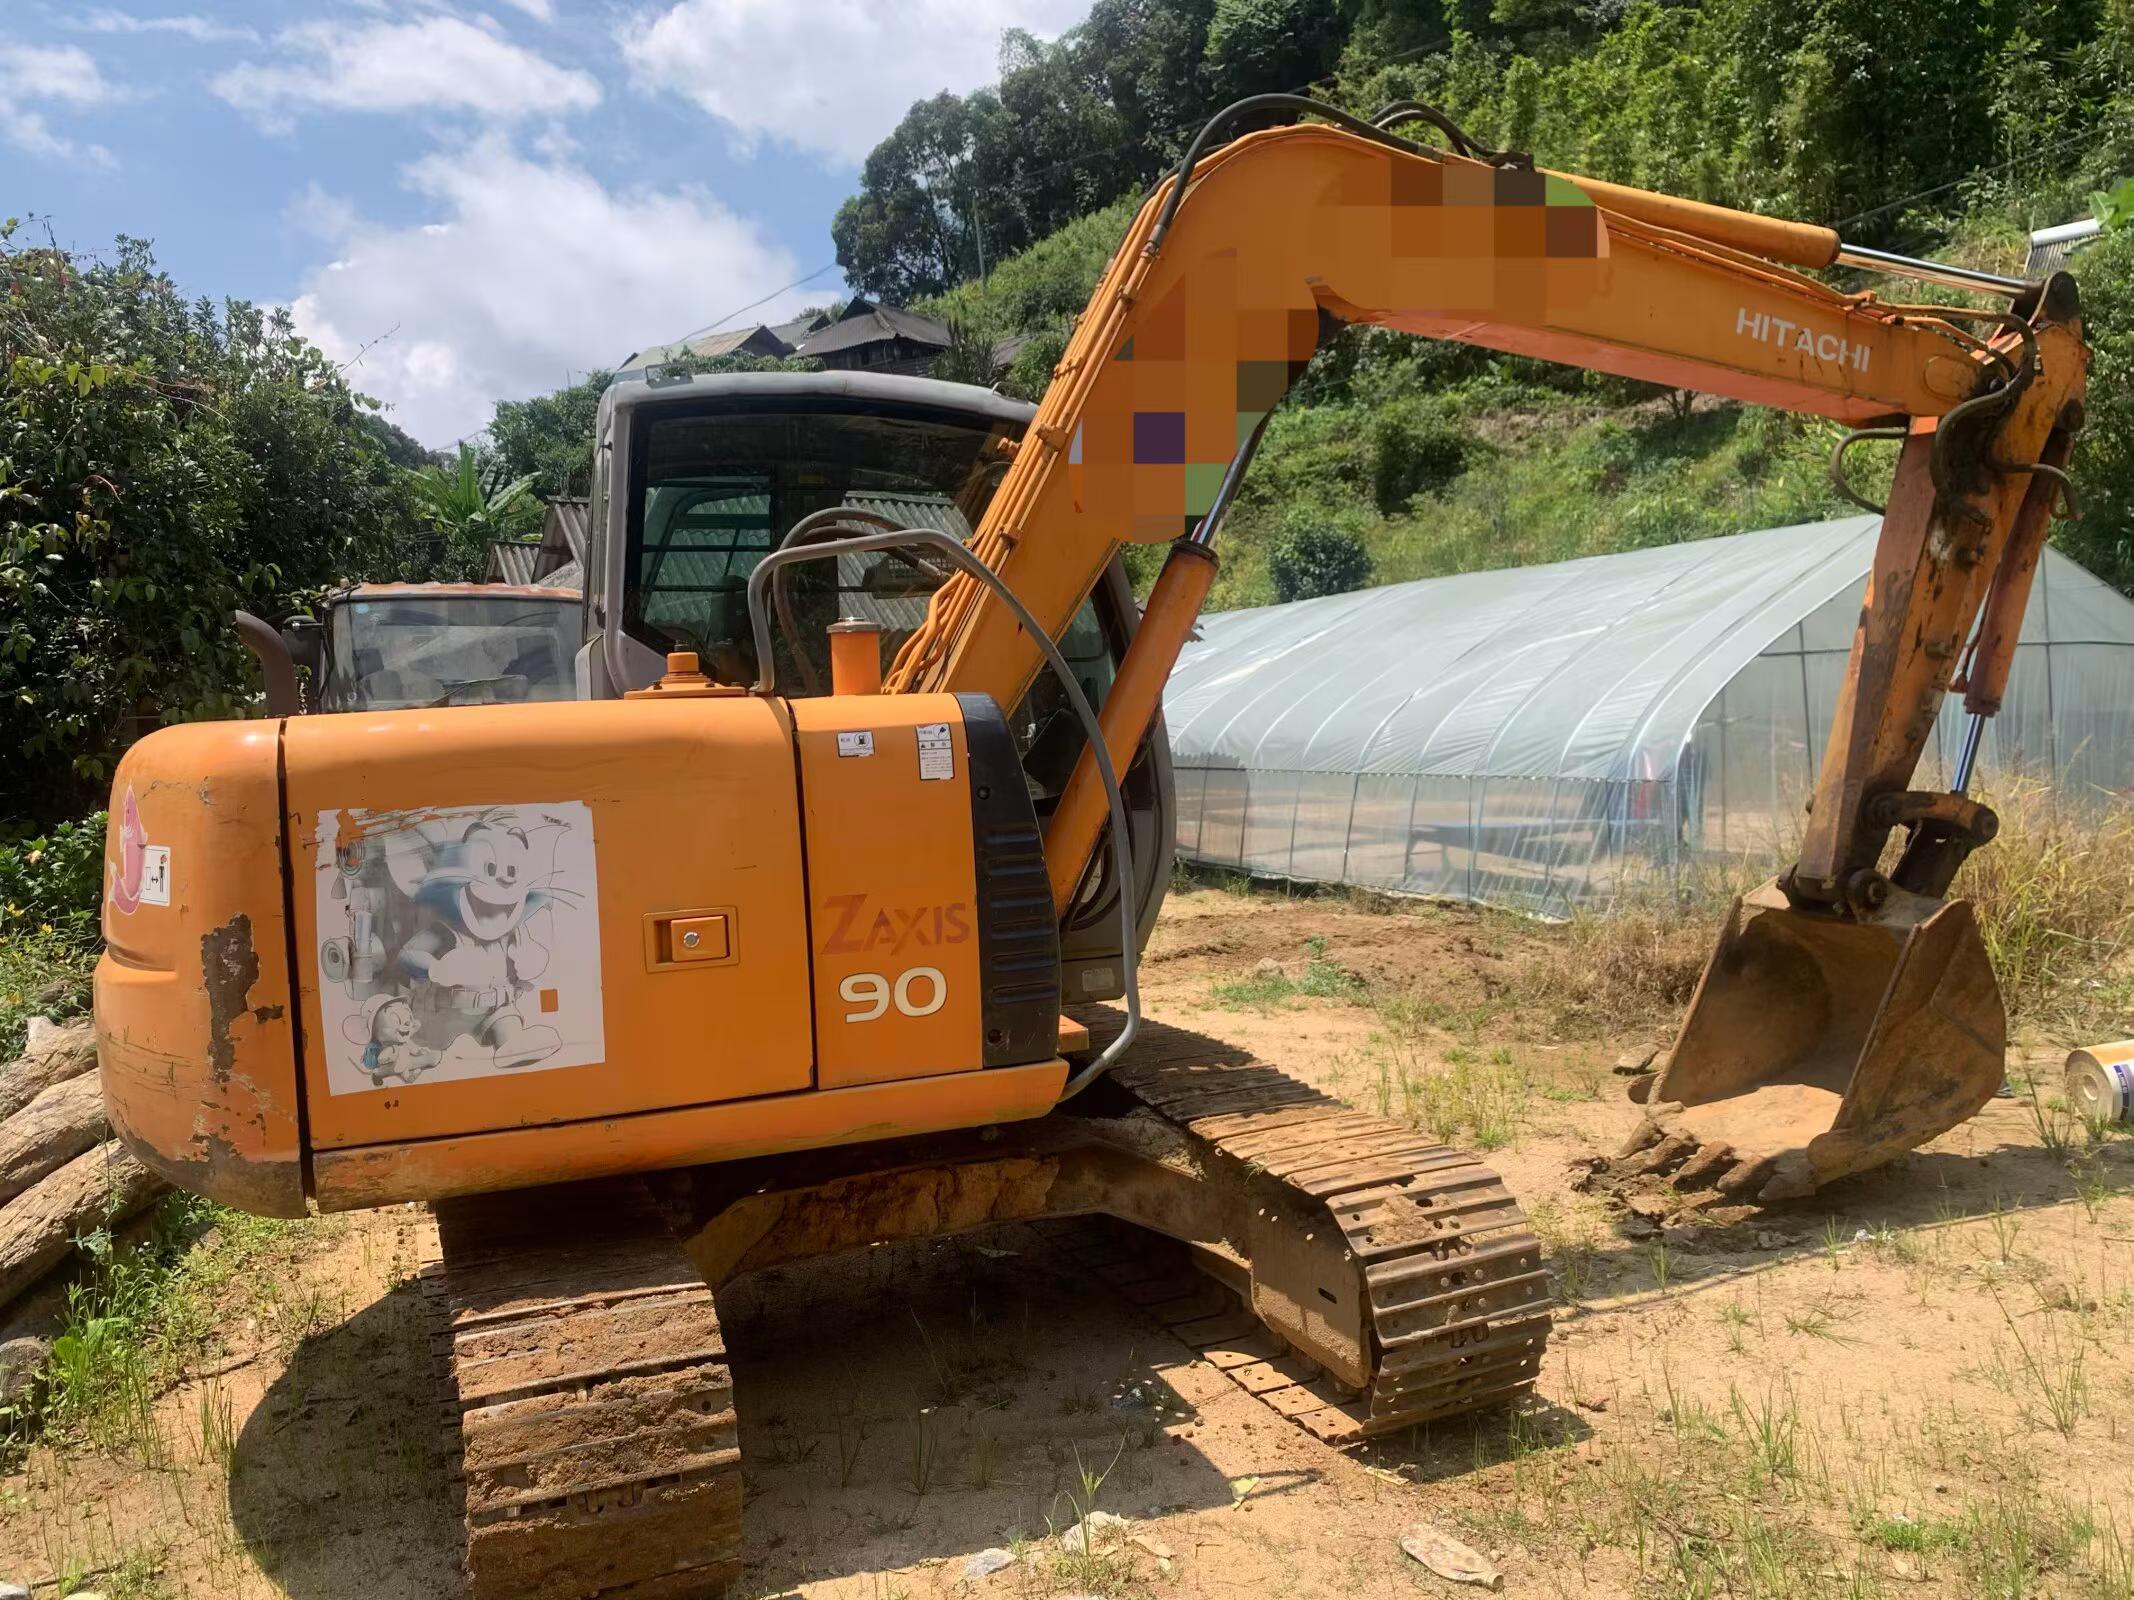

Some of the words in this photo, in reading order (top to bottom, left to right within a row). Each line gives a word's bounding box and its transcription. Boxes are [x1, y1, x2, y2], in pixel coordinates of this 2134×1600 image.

[1736, 308, 1871, 372] HITACHI
[822, 894, 970, 956] ZAXIS
[838, 966, 948, 1024] 90
